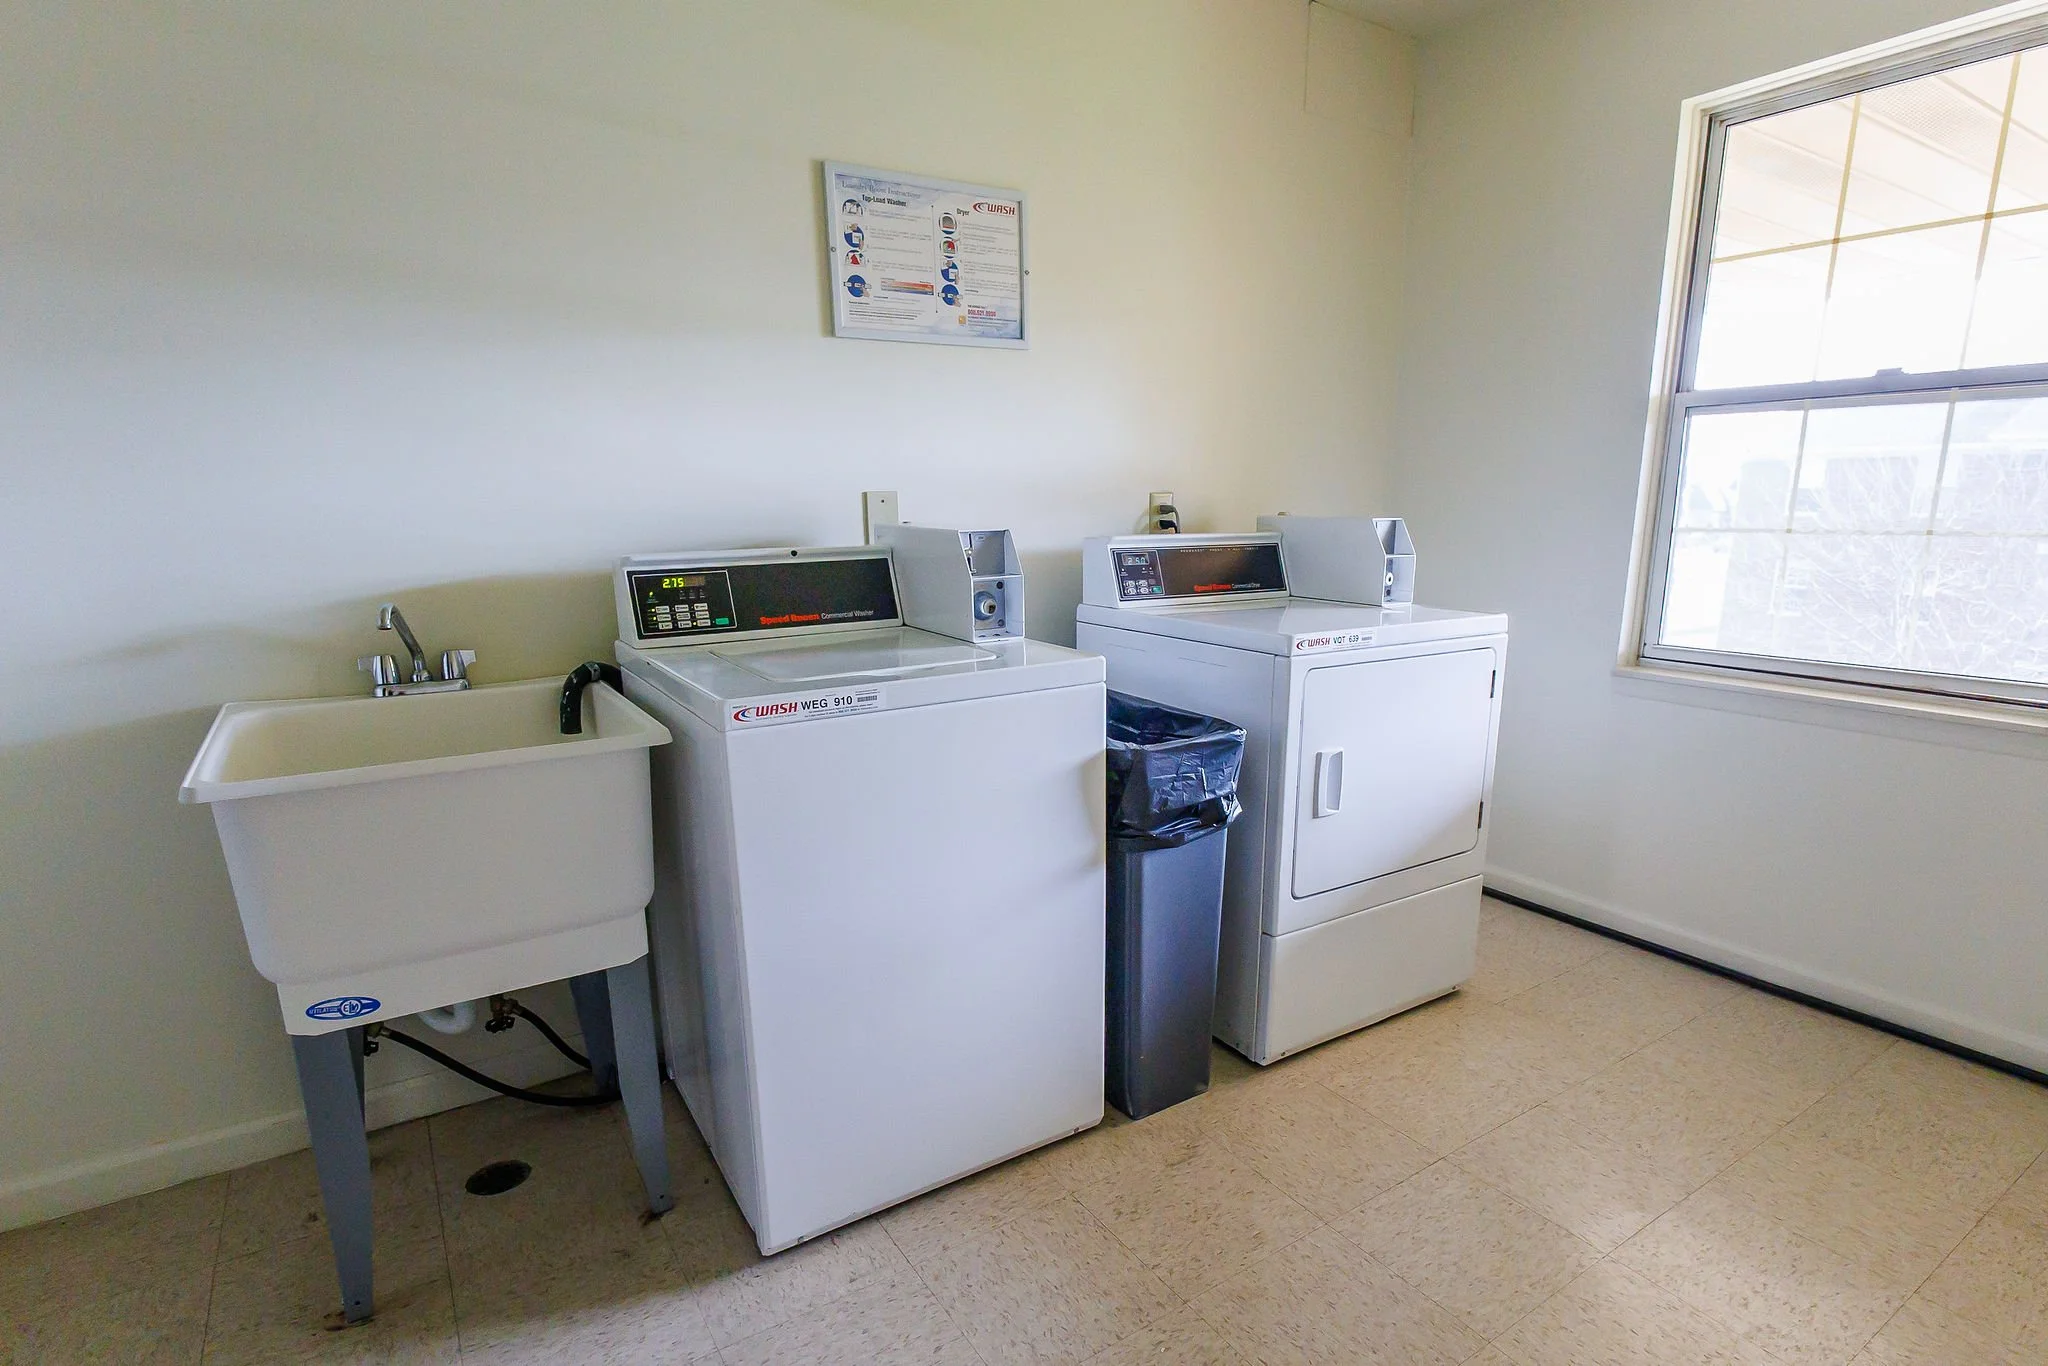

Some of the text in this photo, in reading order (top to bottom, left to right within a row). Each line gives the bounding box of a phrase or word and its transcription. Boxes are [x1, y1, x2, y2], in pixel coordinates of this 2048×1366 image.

[861, 194, 907, 207] Top-Load Washer
[956, 207, 970, 216] Dryer
[987, 203, 1015, 216] WASH
[662, 578, 685, 589] 2.75
[820, 610, 853, 620] Commercial
[853, 609, 874, 617] Washer
[1307, 637, 1331, 647] WASH
[1348, 634, 1360, 642] 639
[755, 701, 798, 717] WASH
[800, 697, 828, 711] WEG
[833, 695, 853, 707] 910
